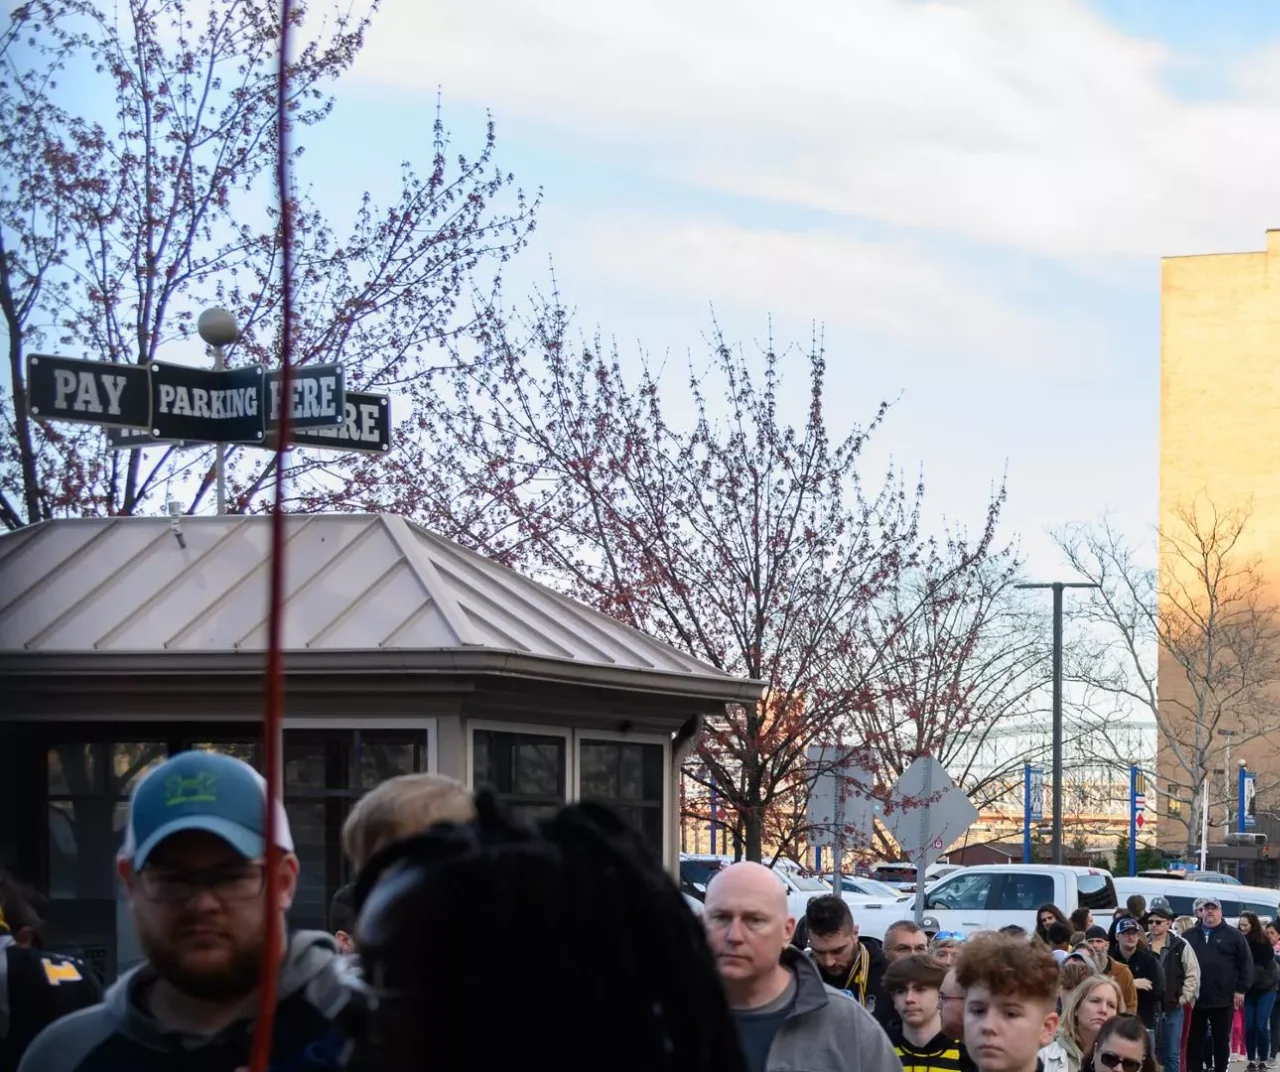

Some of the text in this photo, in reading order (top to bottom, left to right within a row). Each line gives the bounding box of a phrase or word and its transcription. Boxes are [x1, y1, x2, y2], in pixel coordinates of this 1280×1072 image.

[53, 368, 127, 415] PAY
[159, 383, 258, 419] PARKING
[295, 402, 380, 442] RE
